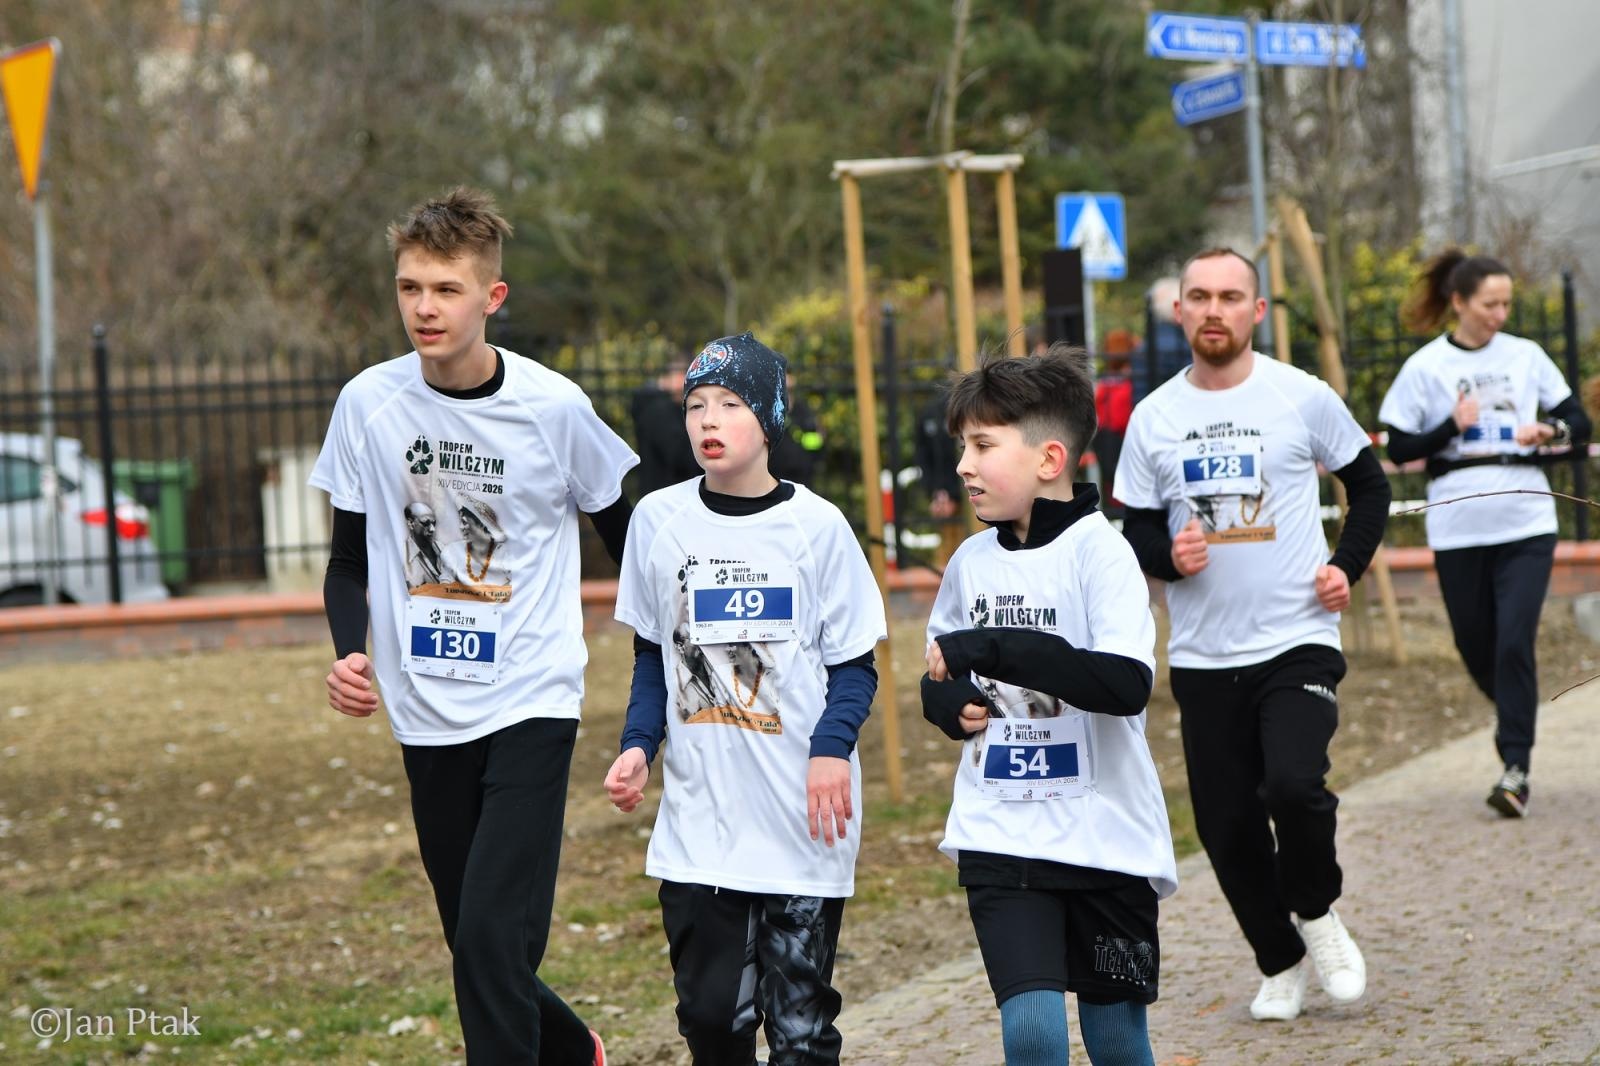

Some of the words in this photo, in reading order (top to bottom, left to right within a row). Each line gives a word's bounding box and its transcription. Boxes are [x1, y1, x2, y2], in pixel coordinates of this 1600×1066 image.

[438, 440, 473, 454] TROPEM
[439, 452, 505, 476] WILCZYM
[1198, 456, 1243, 480] 128
[438, 478, 452, 488] XIV
[452, 480, 481, 492] EDYCJA
[482, 483, 503, 495] 2026
[732, 573, 768, 583] WILCZYM
[724, 590, 765, 618] 49
[994, 595, 1025, 607] TROPEM
[444, 616, 476, 625] WILCZYM
[994, 608, 1057, 627] WILCZYM
[430, 630, 480, 660] 130
[1014, 730, 1051, 740] WILCZYM
[1009, 748, 1050, 777] 54
